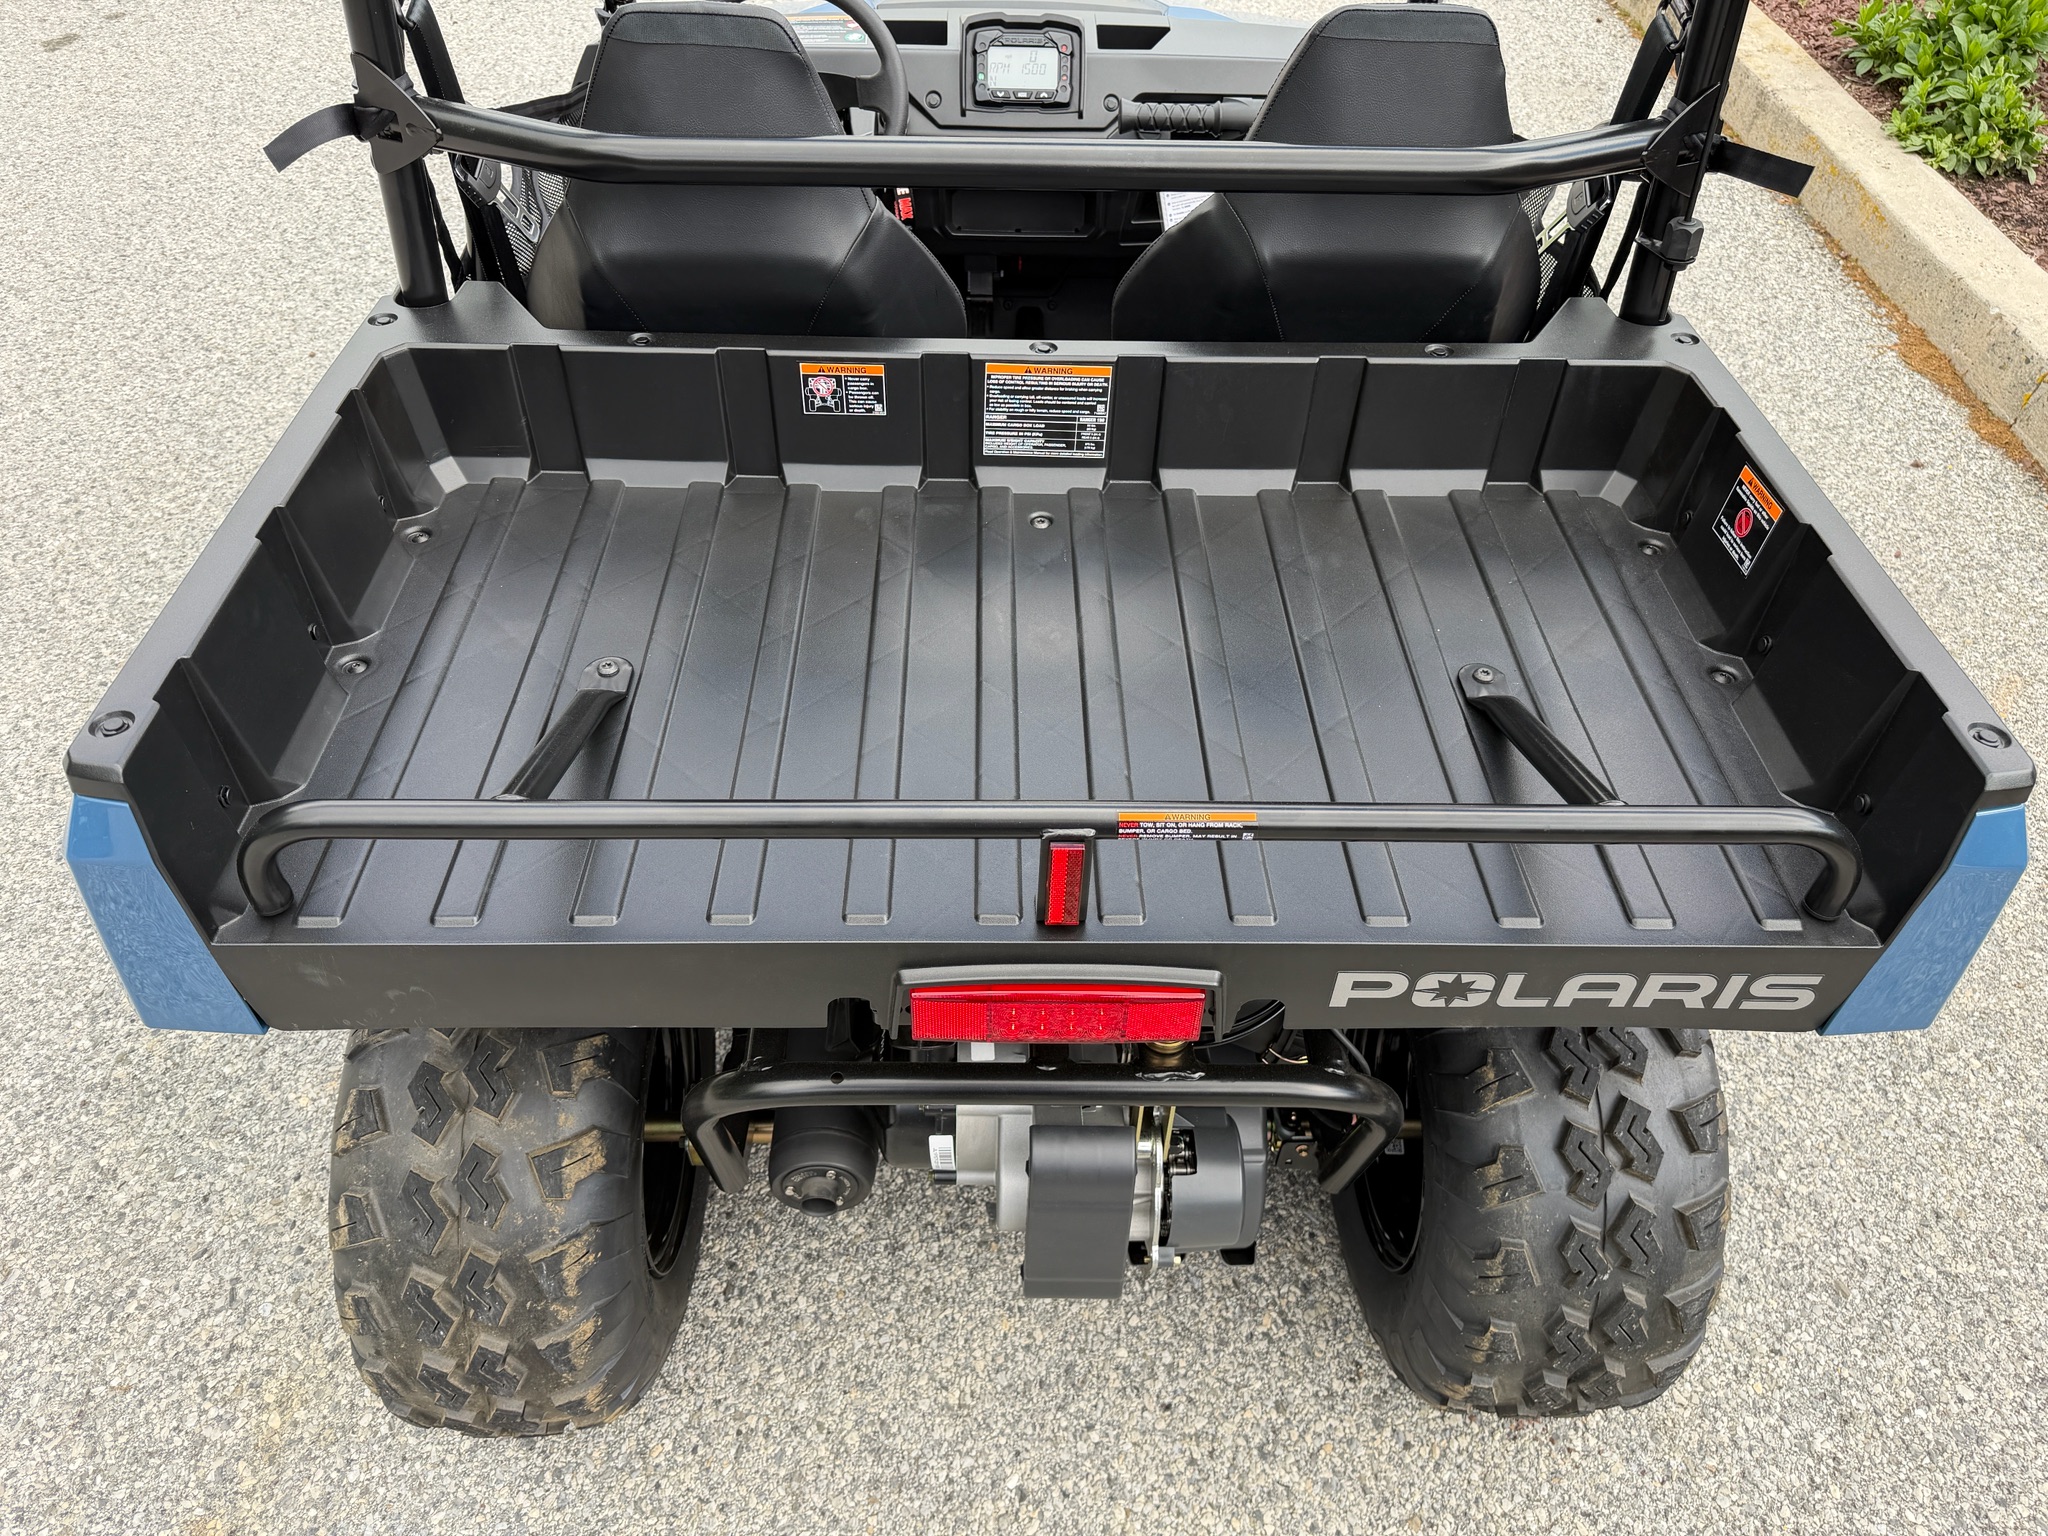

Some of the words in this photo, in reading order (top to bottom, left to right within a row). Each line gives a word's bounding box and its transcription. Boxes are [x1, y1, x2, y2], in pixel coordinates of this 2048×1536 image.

[1022, 63, 1047, 75] 1500
[826, 366, 867, 374] WARNING
[1033, 367, 1073, 375] WARNING
[1752, 482, 1773, 510] WARNING
[1328, 971, 1825, 1010] POLARIS
